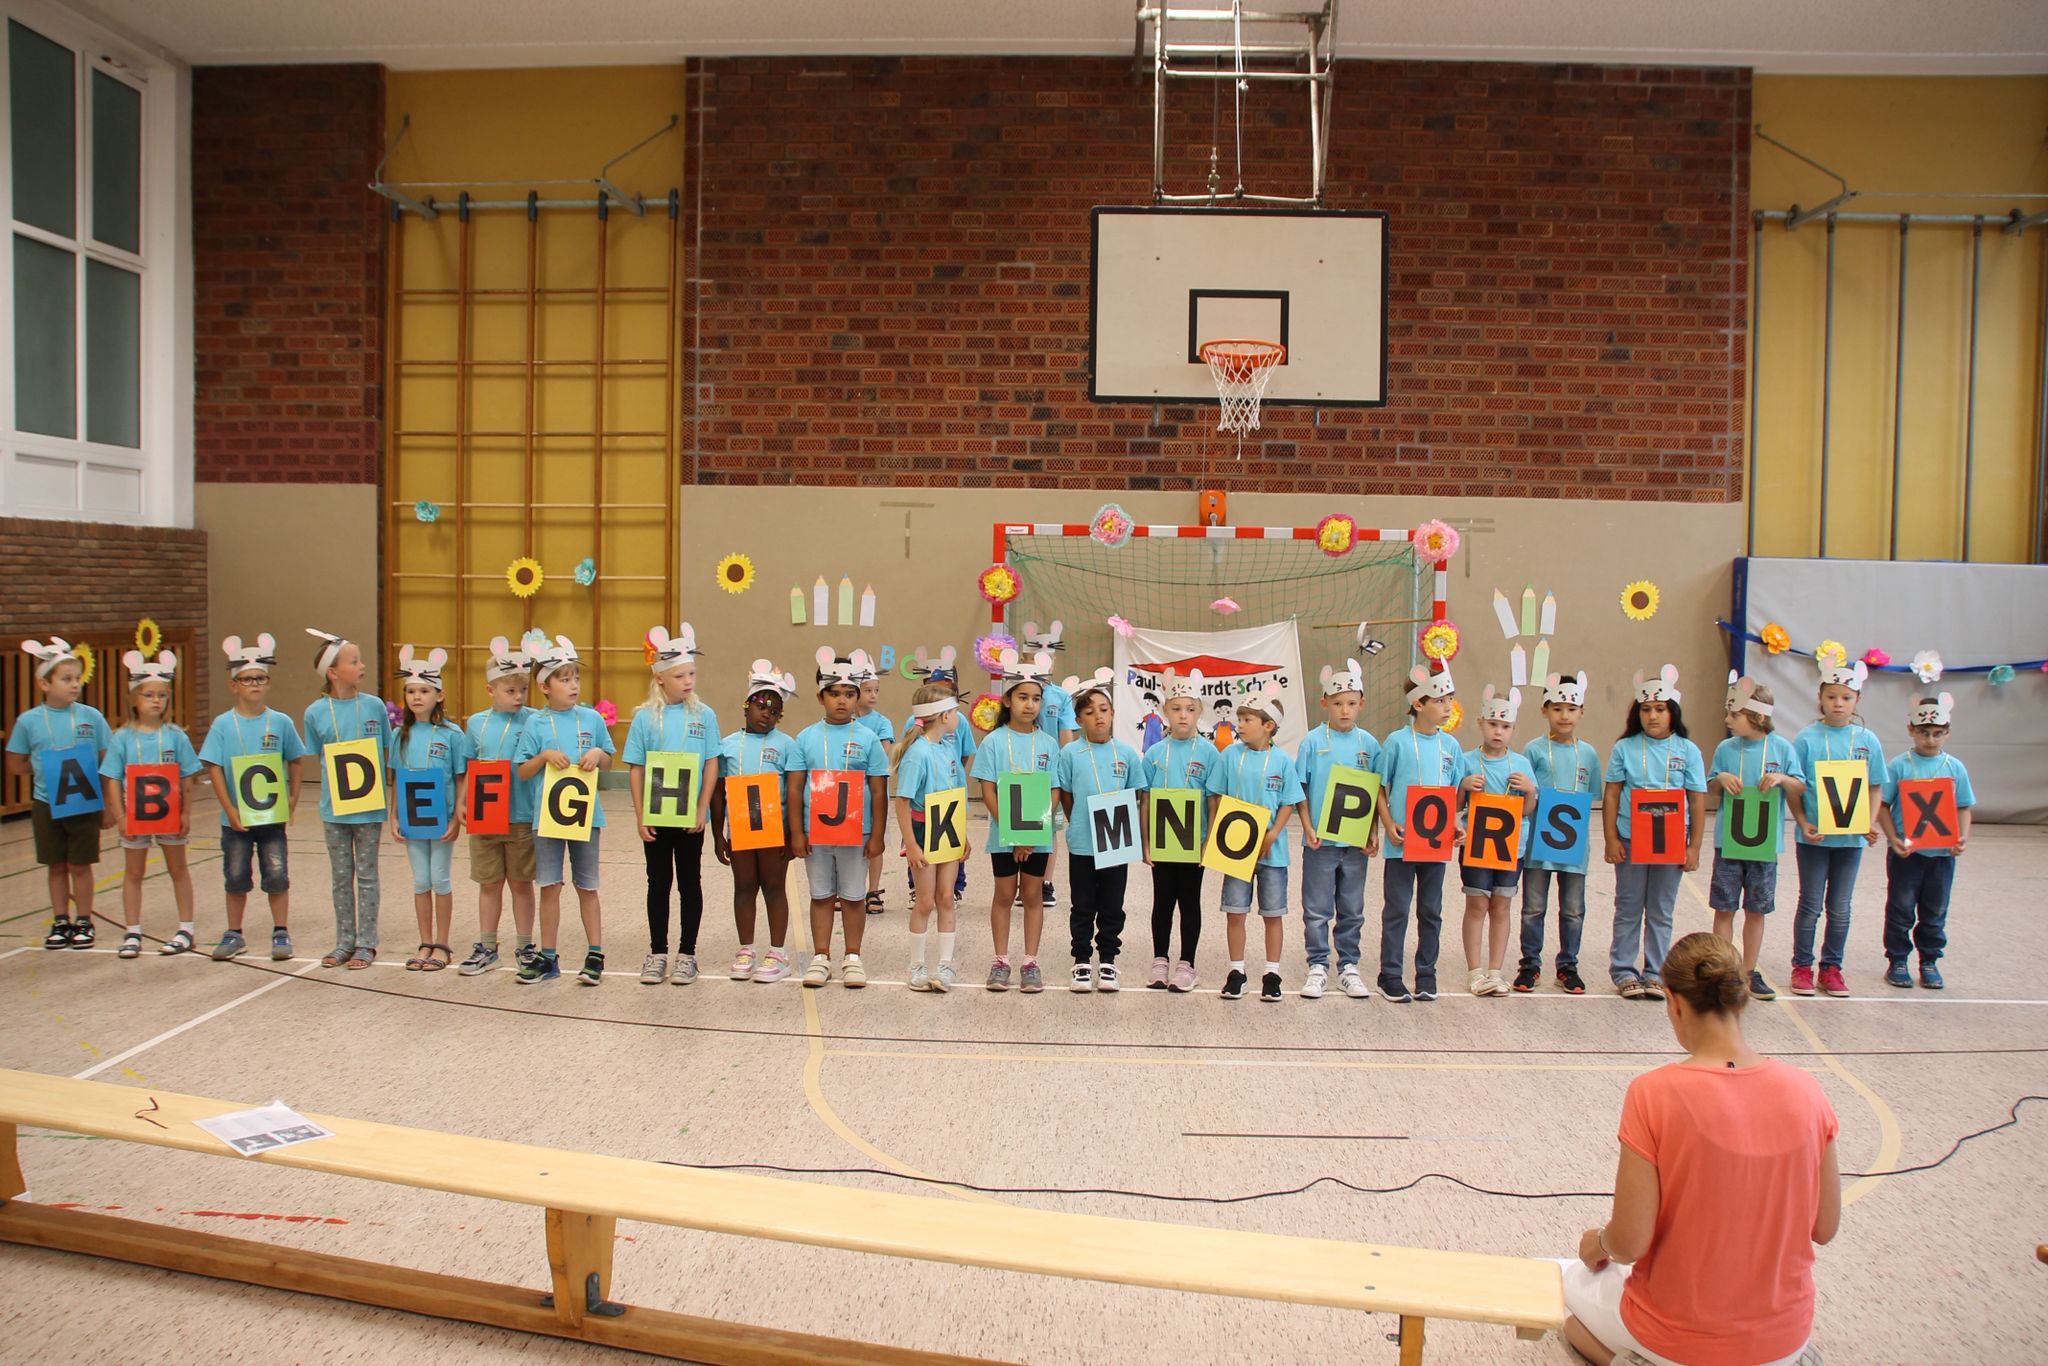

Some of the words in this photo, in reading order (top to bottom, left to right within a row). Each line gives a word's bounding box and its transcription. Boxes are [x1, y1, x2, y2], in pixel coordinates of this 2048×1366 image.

[56, 759, 98, 805] A
[136, 777, 170, 820] B
[240, 765, 278, 810] C
[334, 754, 375, 800] D
[475, 775, 502, 820] F
[650, 769, 690, 815] H
[406, 782, 438, 826] E
[549, 777, 589, 827] G
[748, 786, 762, 830] I
[819, 783, 847, 825] J
[1010, 784, 1043, 830] L
[1156, 799, 1194, 850] N
[1327, 783, 1371, 834] P
[1414, 795, 1447, 848] Q
[1731, 798, 1769, 847] U
[1823, 777, 1861, 828] V
[1911, 792, 1950, 836] X
[930, 801, 960, 852] K
[1094, 805, 1132, 852] M
[1217, 811, 1258, 859] O
[1472, 807, 1514, 861] R
[1541, 804, 1581, 849] S
[1637, 802, 1678, 853] T
